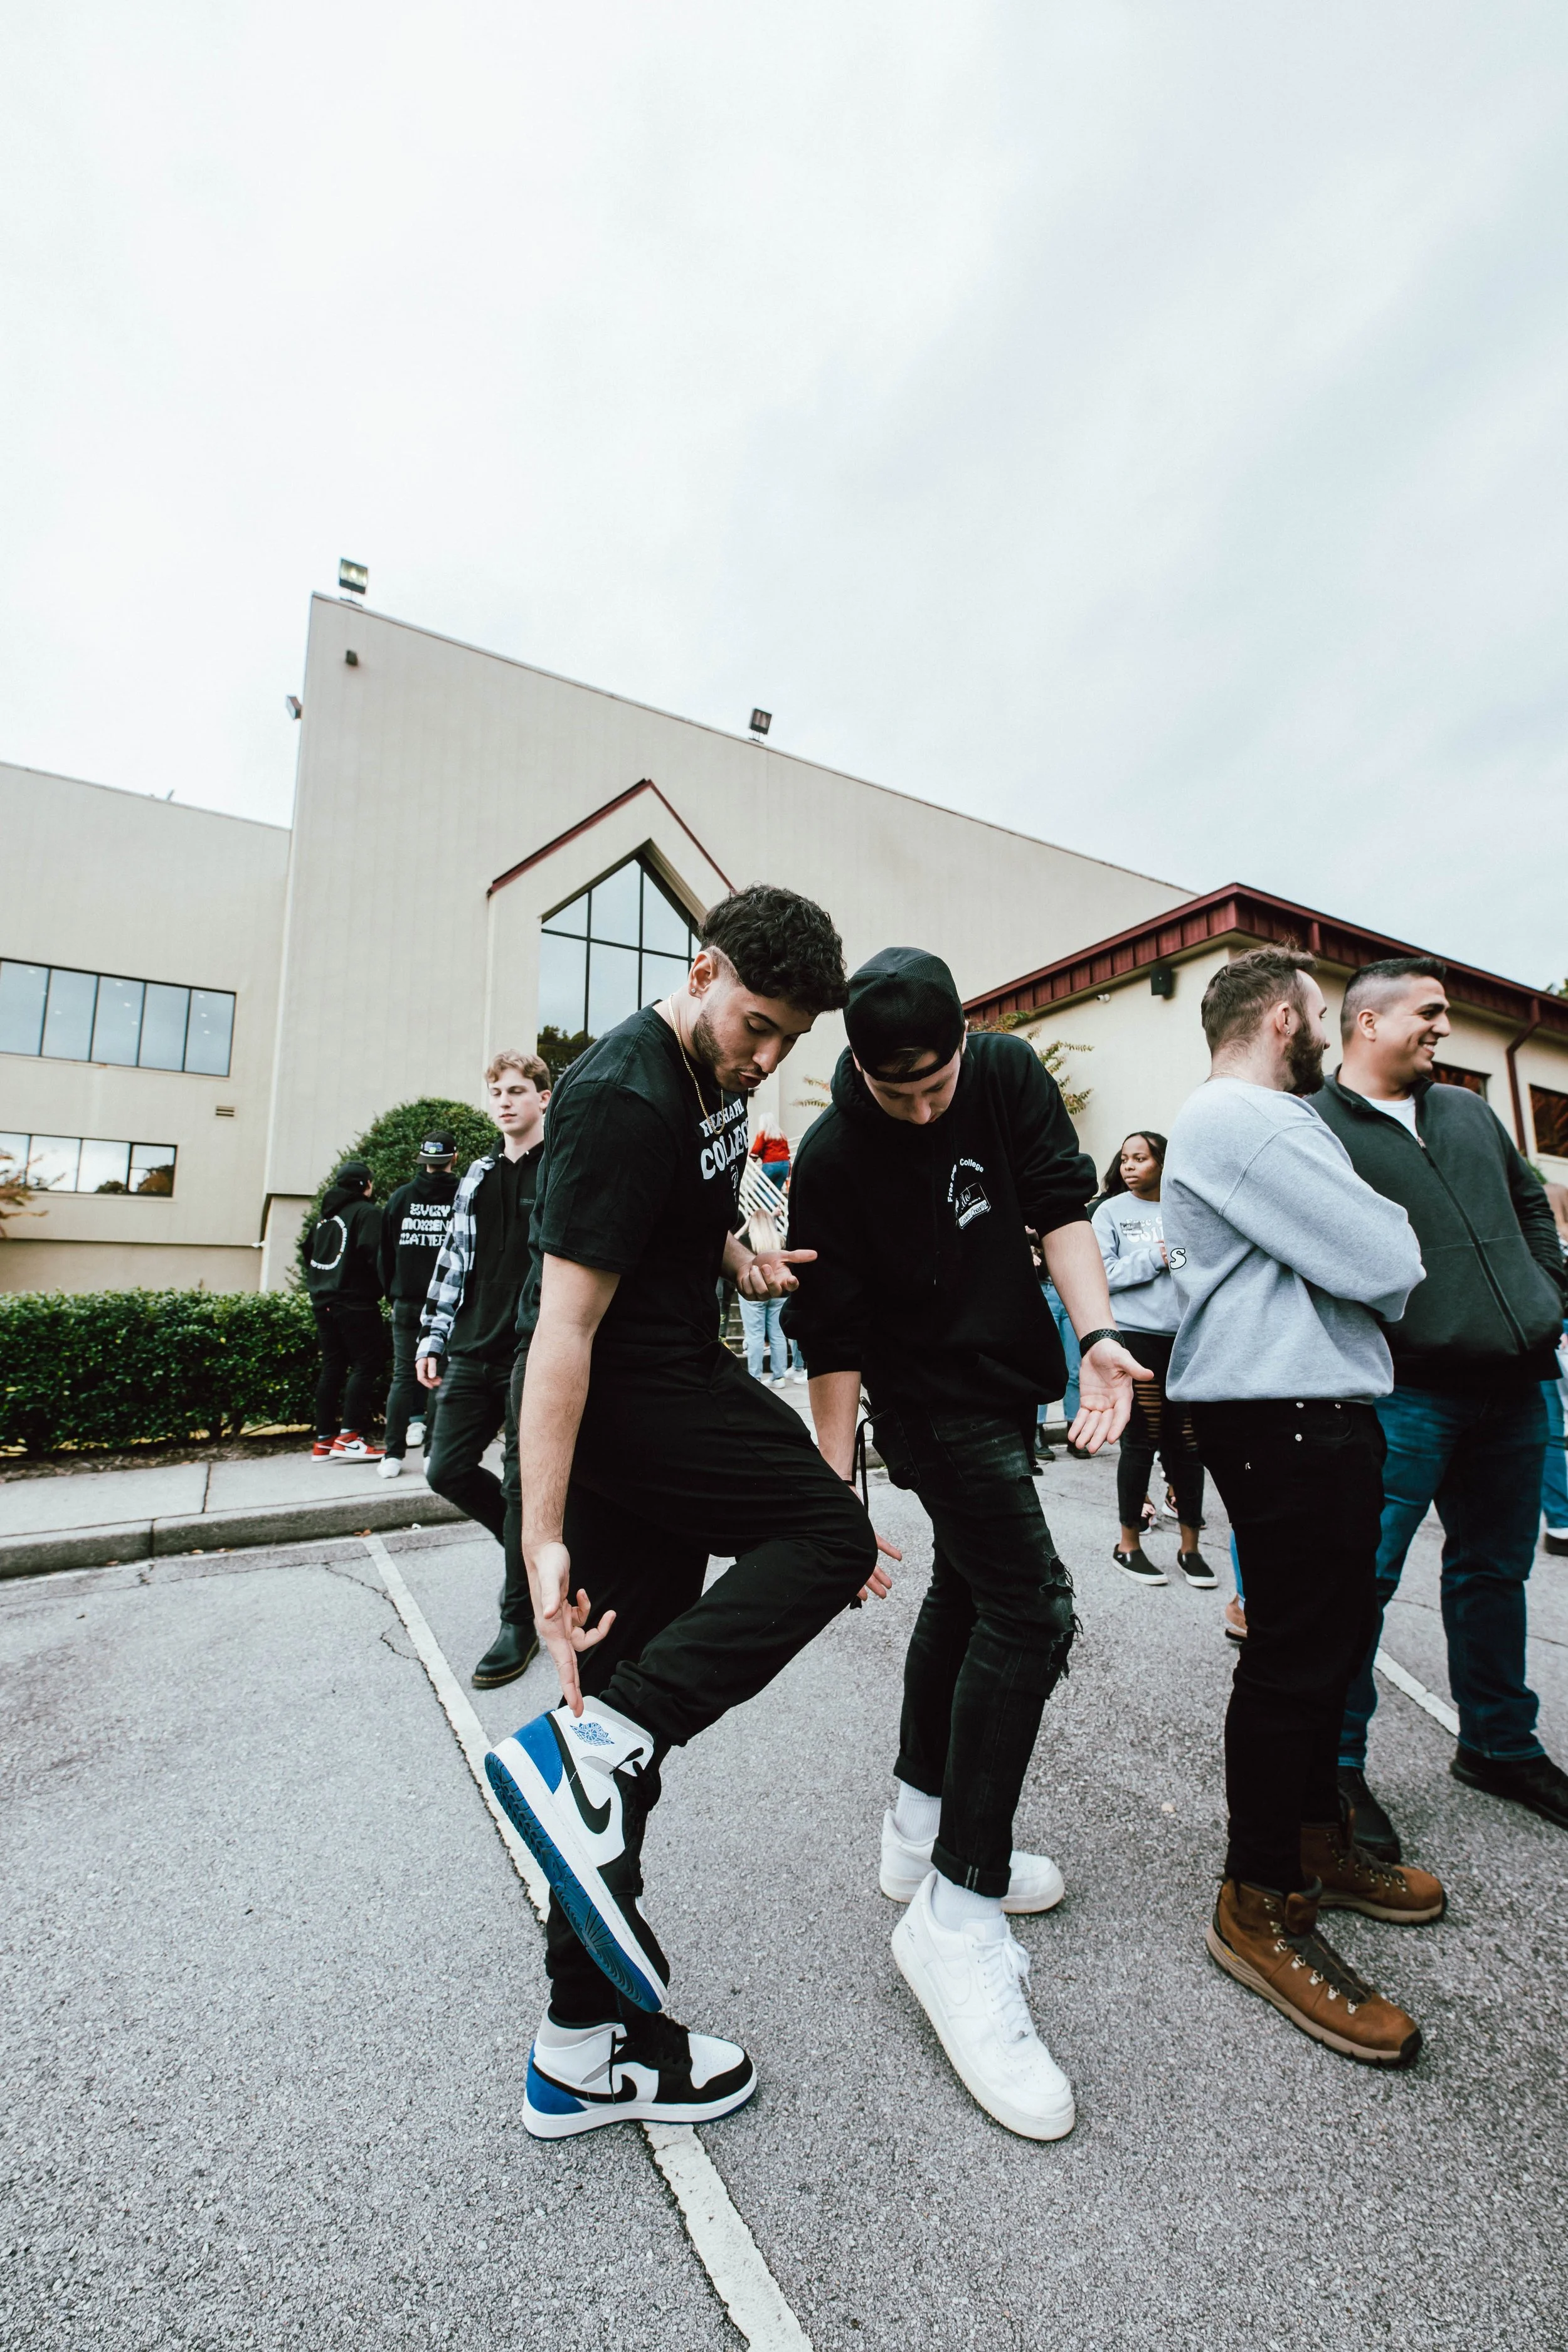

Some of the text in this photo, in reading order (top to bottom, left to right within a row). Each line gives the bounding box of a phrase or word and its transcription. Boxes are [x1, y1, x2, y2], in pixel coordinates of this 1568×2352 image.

[960, 1158, 984, 1172] College
[401, 1217, 450, 1231] MOMEN
[1170, 1248, 1187, 1269] S
